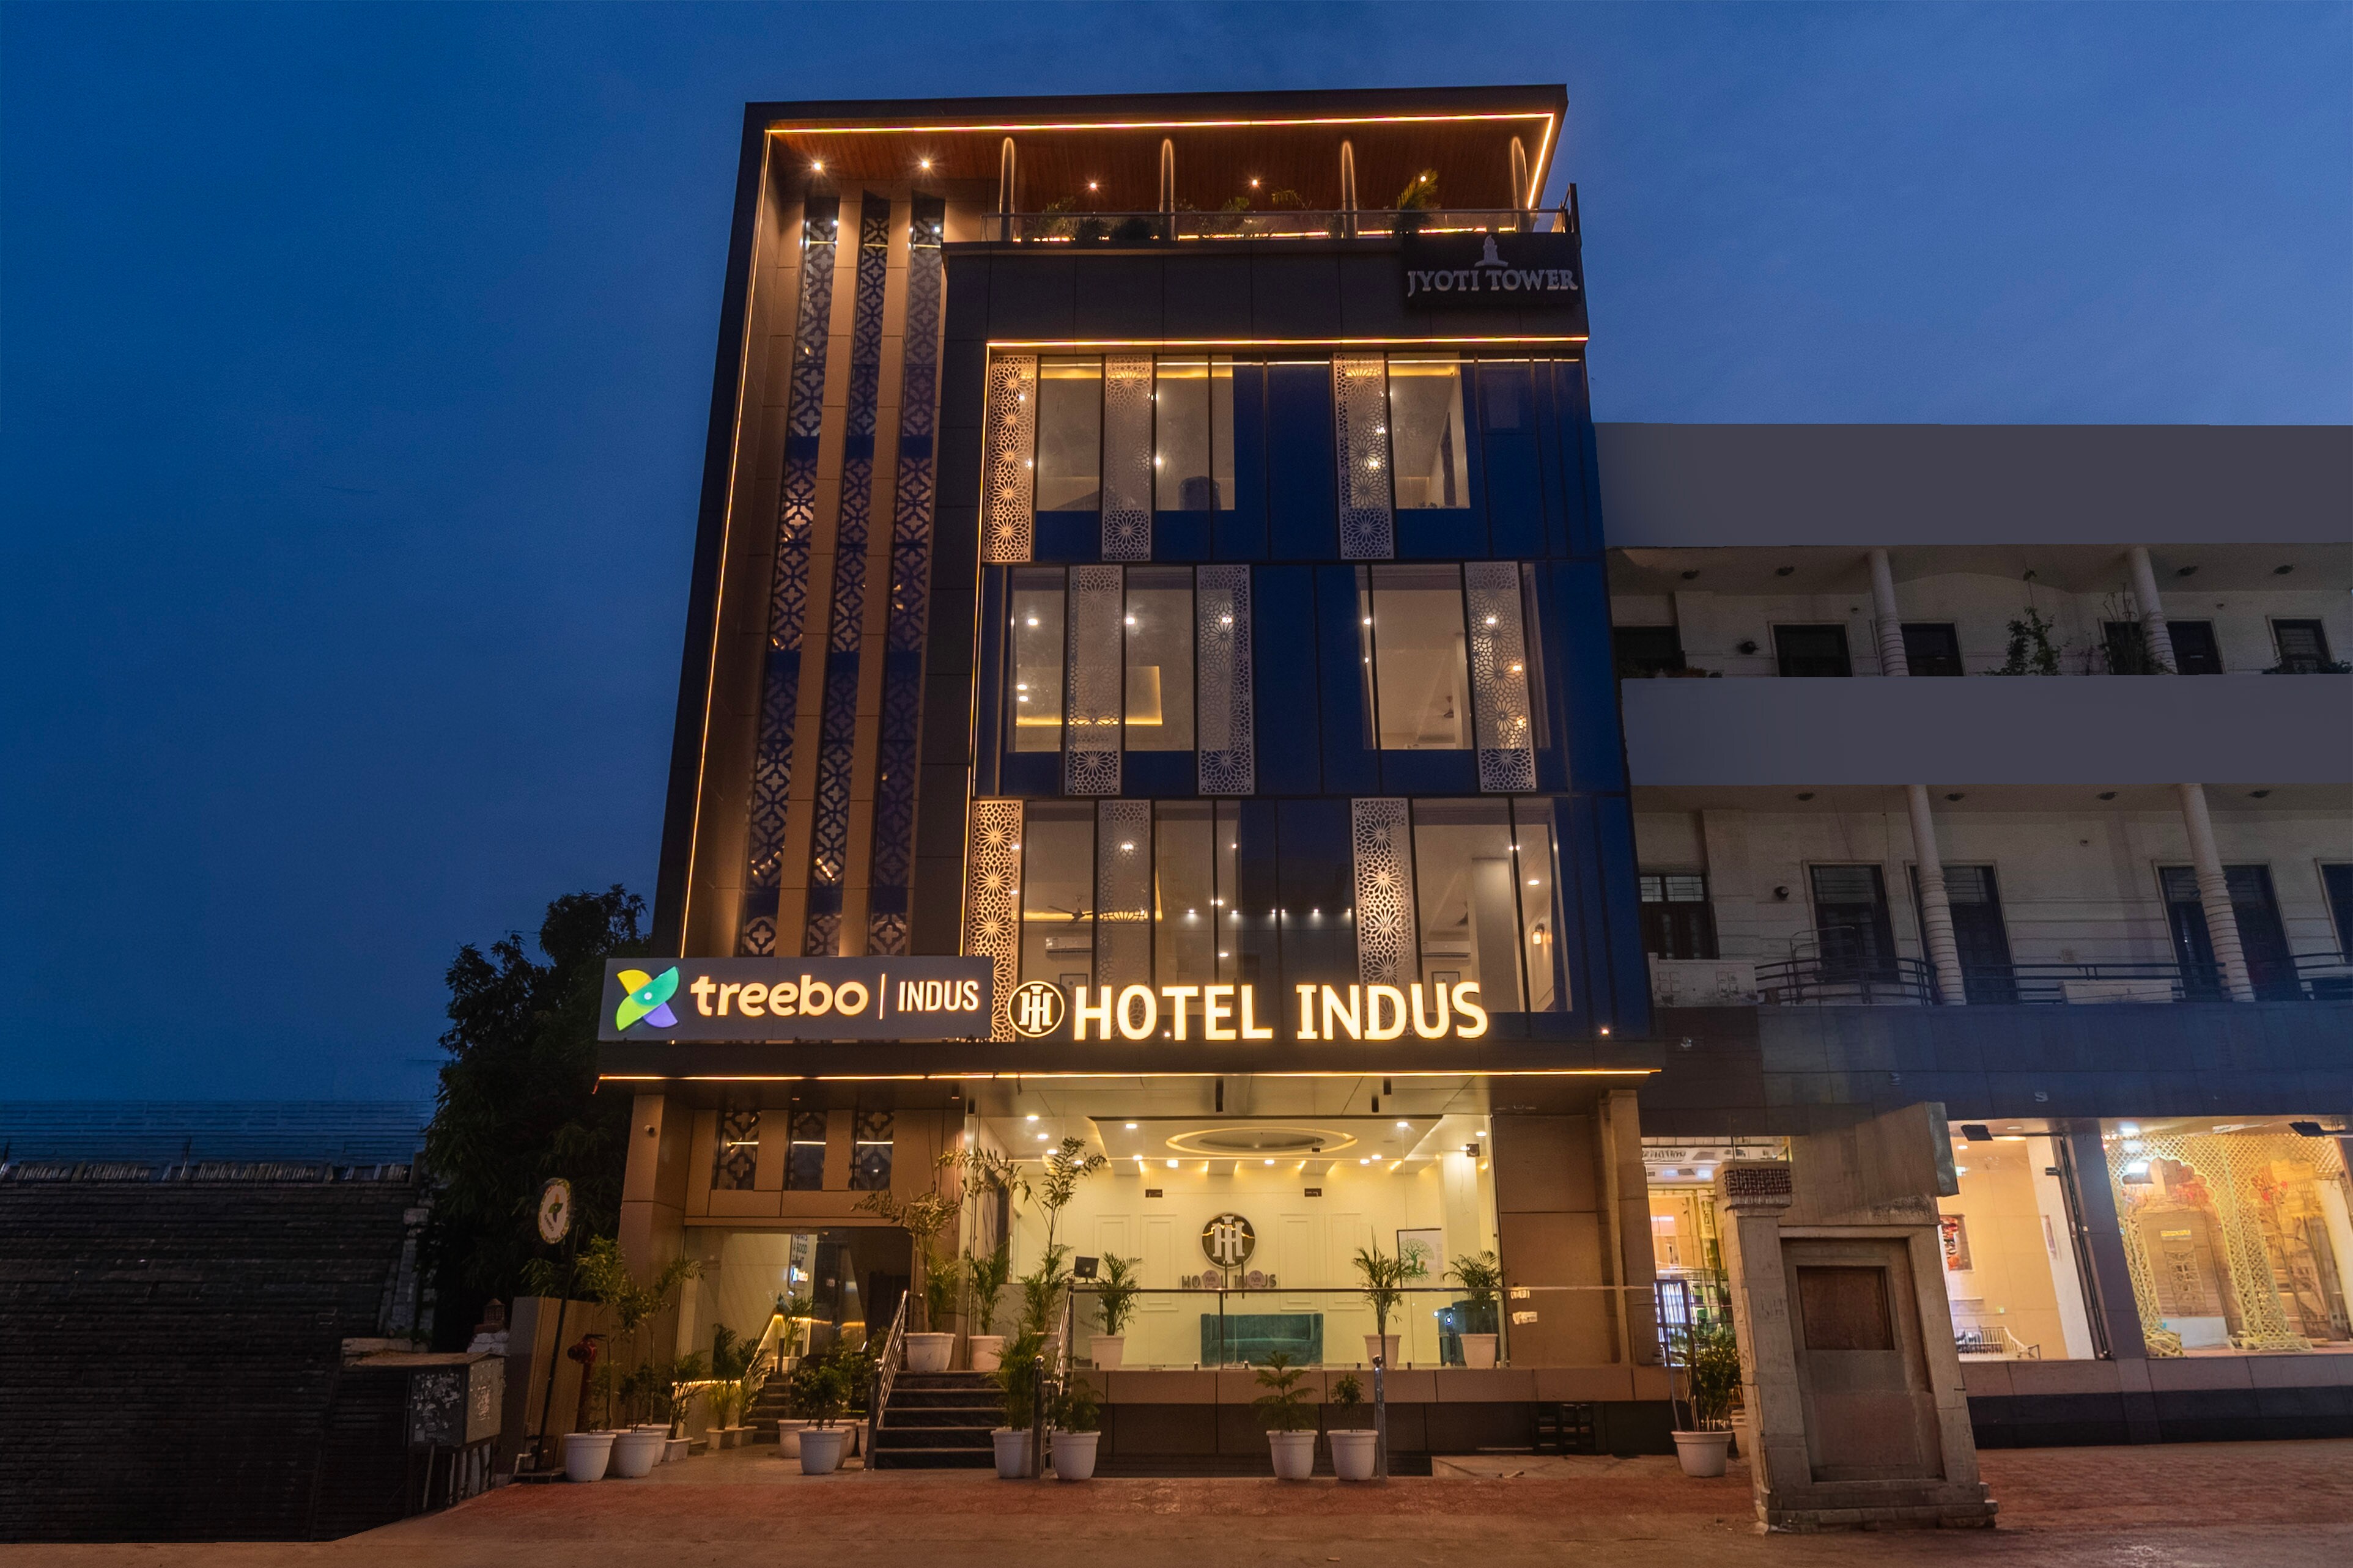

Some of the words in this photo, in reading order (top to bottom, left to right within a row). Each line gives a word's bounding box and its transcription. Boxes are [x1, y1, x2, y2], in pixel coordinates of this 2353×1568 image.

[1408, 270, 1480, 297] JYOTI
[1485, 269, 1579, 291] TOWER
[690, 974, 869, 1017] treebo
[898, 980, 980, 1012] INDUS
[1073, 984, 1273, 1041] HOTEL
[1296, 981, 1488, 1040] INDUS
